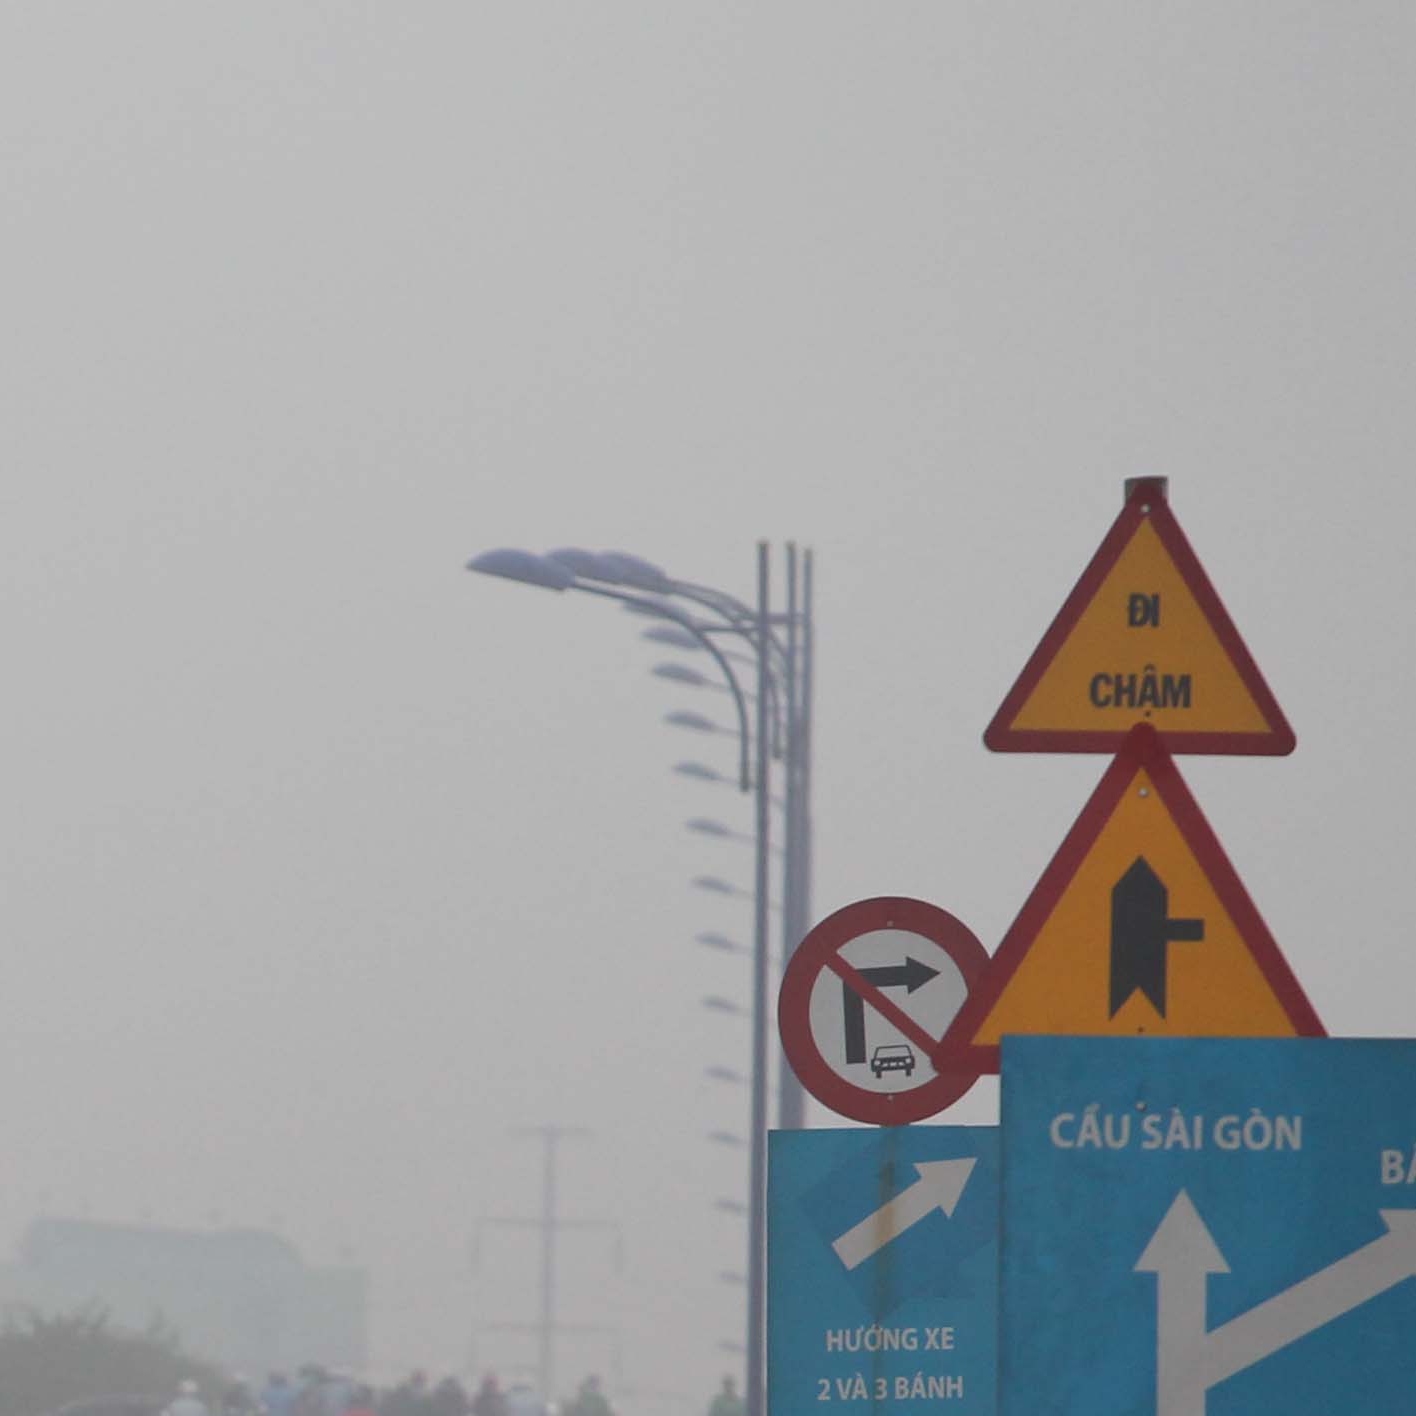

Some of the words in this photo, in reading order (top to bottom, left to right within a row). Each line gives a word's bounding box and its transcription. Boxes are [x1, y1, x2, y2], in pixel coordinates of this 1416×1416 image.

[1128, 592, 1160, 628] ĐI
[1141, 1107, 1203, 1150] SÀI
[1213, 1108, 1302, 1151] GÒN
[925, 1327, 955, 1350] XE
[817, 1378, 832, 1401] 2
[836, 1372, 868, 1400] VÀ
[874, 1377, 888, 1400] 3
[894, 1371, 964, 1400] BÁNH
